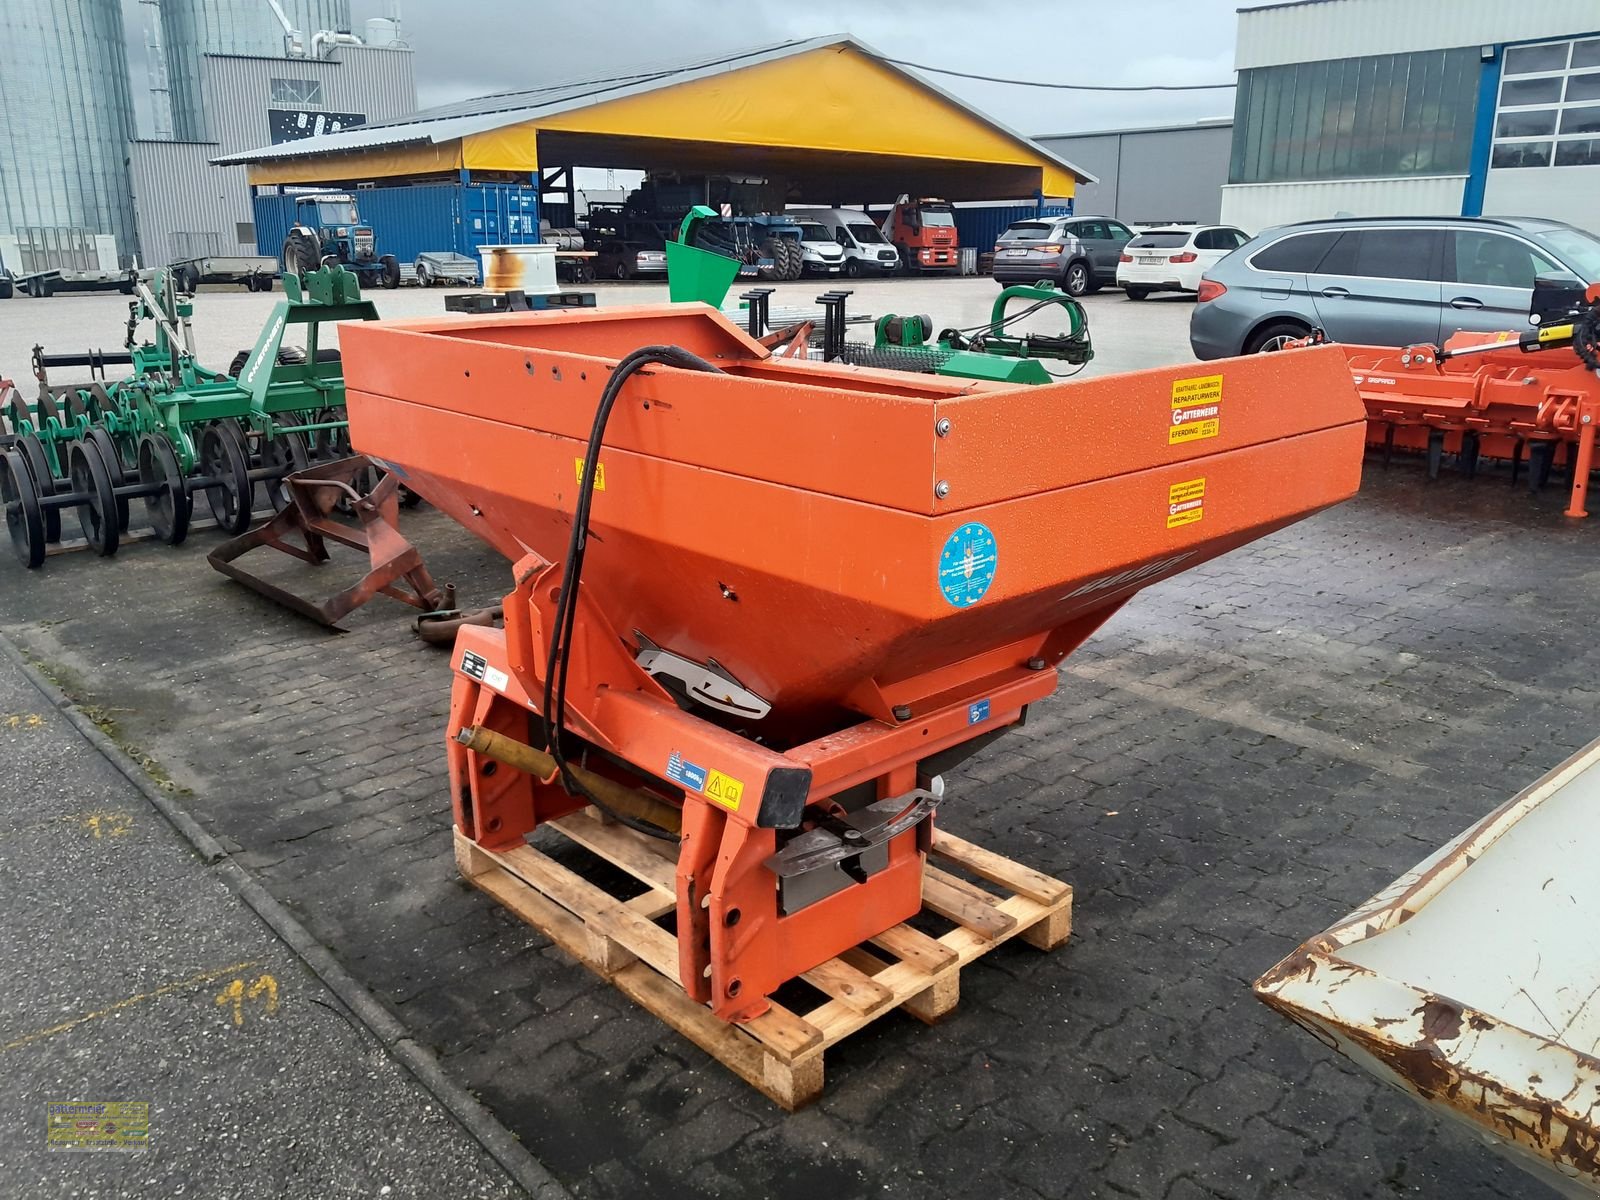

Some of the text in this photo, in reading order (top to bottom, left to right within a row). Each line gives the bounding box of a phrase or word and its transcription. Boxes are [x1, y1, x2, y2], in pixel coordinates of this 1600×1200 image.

[252, 316, 282, 374] KERNER
[1174, 391, 1220, 404] REPARATURWERK
[1172, 406, 1218, 425] GATTERMEIER
[1172, 427, 1198, 438] EFERDING
